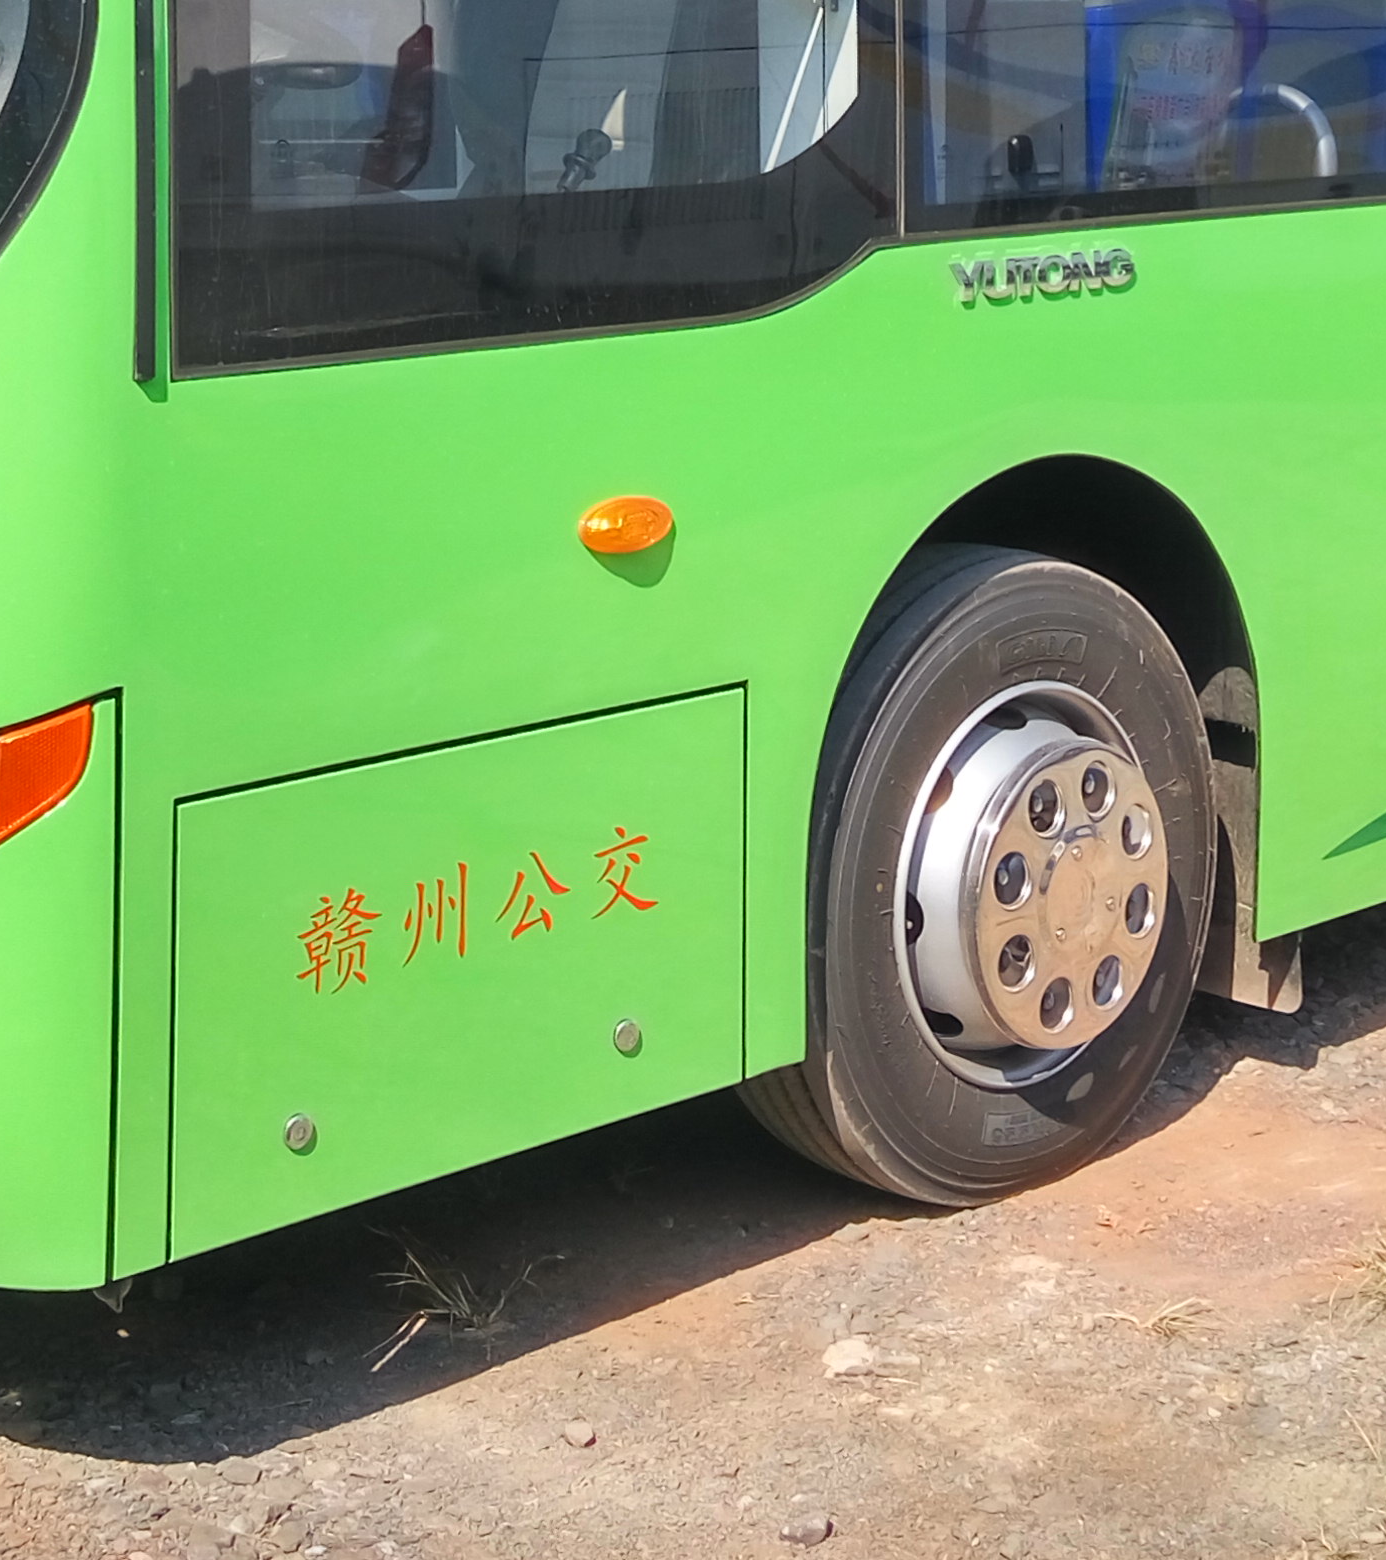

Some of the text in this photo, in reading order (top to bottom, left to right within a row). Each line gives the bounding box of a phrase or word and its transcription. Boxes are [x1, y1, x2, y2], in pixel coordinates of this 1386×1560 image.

[949, 248, 1135, 302] YUTONG
[296, 826, 659, 994] 赣州公交
